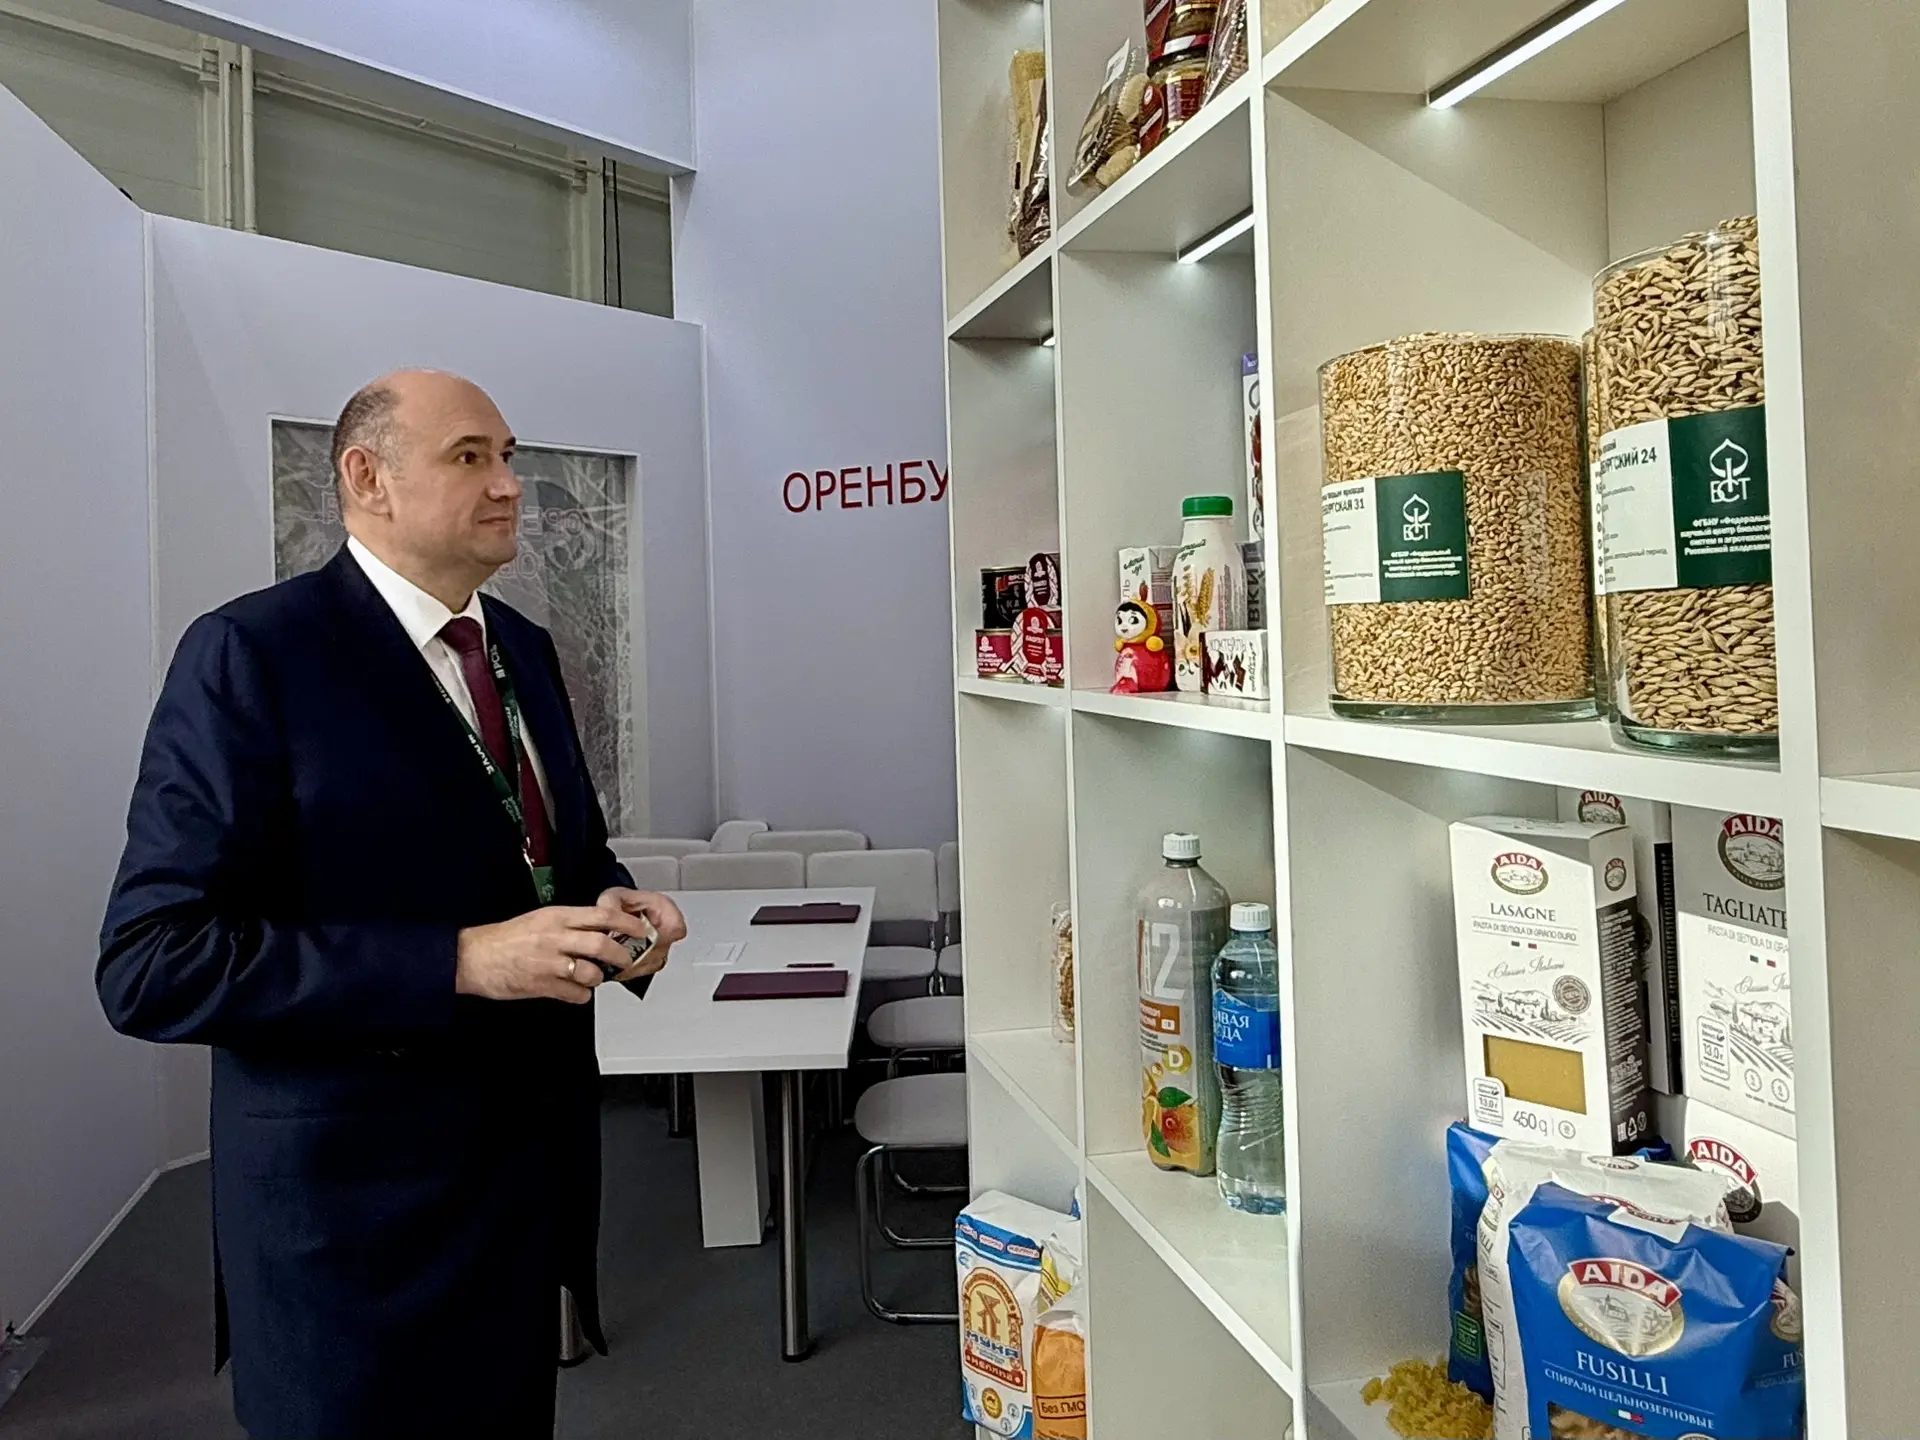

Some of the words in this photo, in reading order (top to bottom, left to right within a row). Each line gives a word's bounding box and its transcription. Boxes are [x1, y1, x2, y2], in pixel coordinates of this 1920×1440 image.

[1640, 447, 1657, 465] 24
[783, 459, 949, 513] ОРЕНБУ
[1354, 498, 1365, 510] 31
[1584, 791, 1616, 807] AIDA
[1731, 815, 1783, 841] AIDA
[1499, 854, 1538, 870] AIDA
[1490, 903, 1557, 922] LASAGNE
[1168, 1050, 1184, 1068] D
[1513, 1110, 1537, 1130] 450
[1539, 1119, 1548, 1137] g
[1696, 1141, 1750, 1179] AIDA
[1582, 1263, 1669, 1303] AIDA
[1576, 1350, 1670, 1396] FUSILLI
[1544, 1368, 1597, 1394] СПИРАЛИ
[1599, 1387, 1717, 1430] ЦЕЛЬНОЗЕРНОВЫЕ
